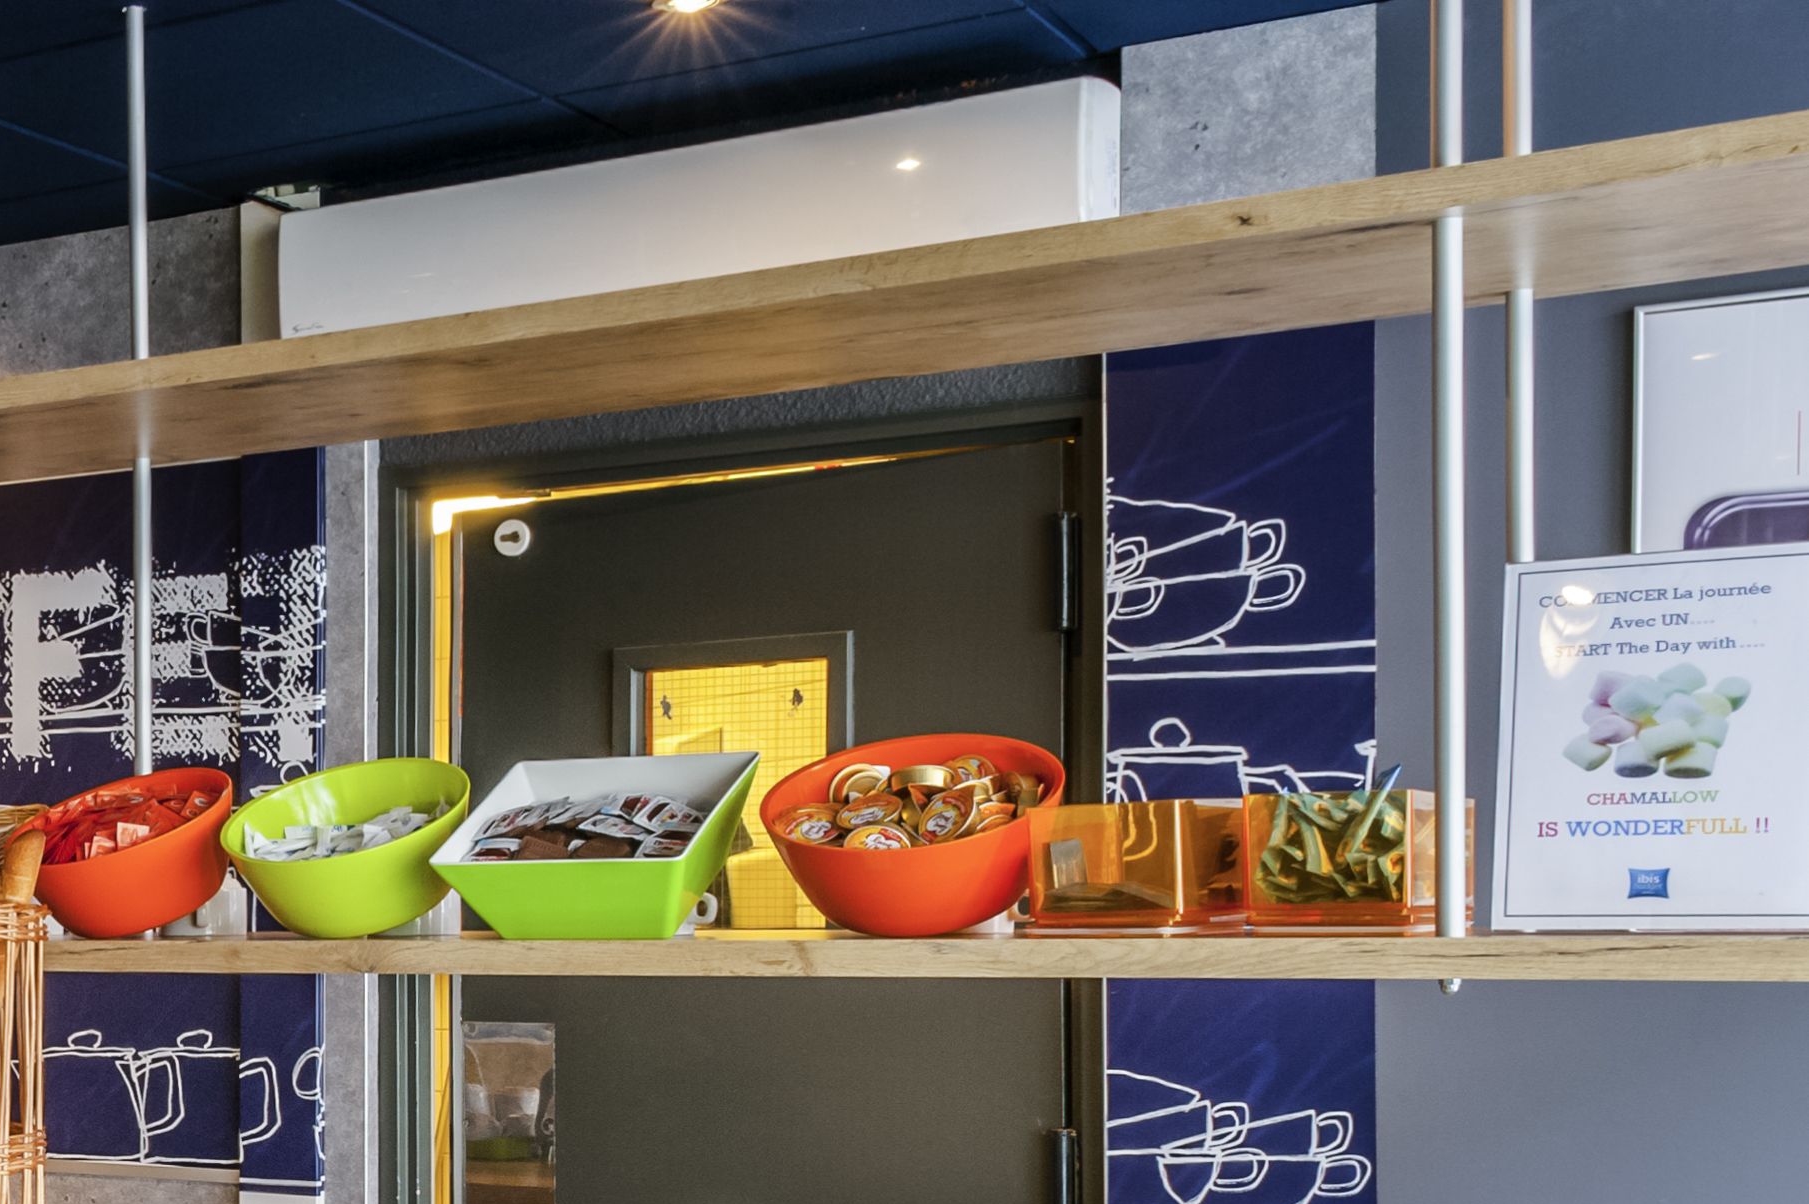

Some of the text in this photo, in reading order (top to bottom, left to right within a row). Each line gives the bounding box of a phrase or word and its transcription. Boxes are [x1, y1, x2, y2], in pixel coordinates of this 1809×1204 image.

[1538, 583, 1772, 608] COMENCER La journée
[1609, 616, 1656, 630] Avec
[1555, 643, 1611, 658] START
[1616, 642, 1650, 655] The
[1655, 640, 1692, 654] Day
[1696, 636, 1736, 650] with
[1587, 790, 1719, 806] CHAMALLOW
[1537, 821, 1559, 838] IS
[1566, 817, 1747, 837] WONDERFULL
[1637, 874, 1660, 884] ibis
